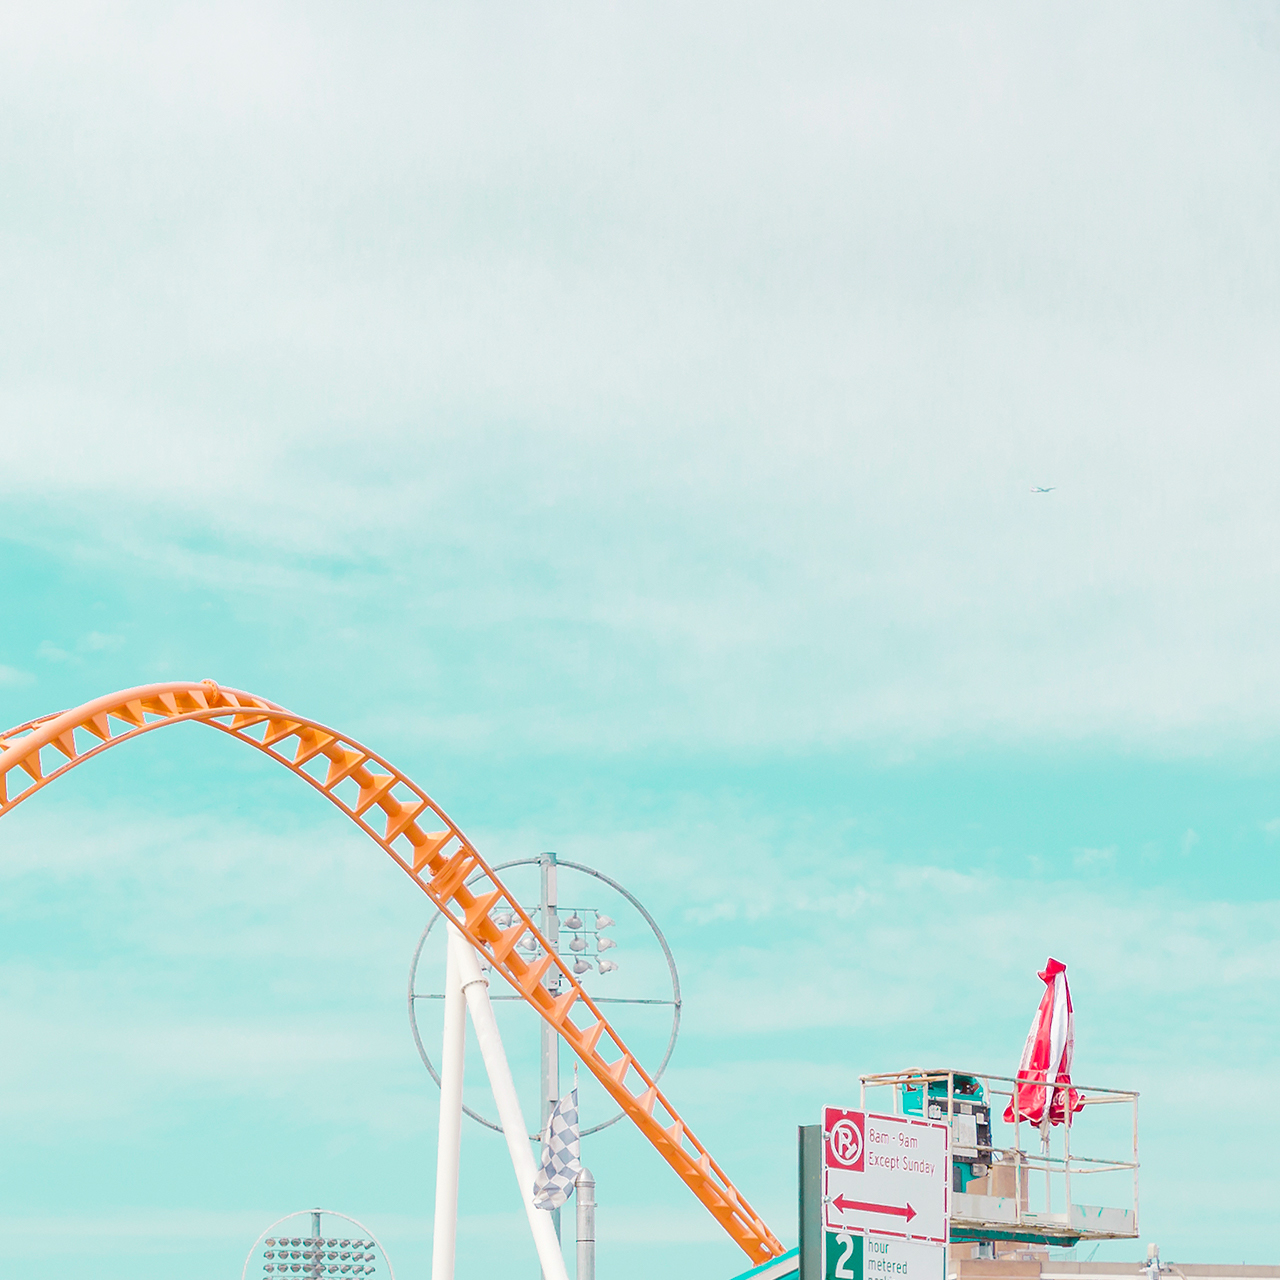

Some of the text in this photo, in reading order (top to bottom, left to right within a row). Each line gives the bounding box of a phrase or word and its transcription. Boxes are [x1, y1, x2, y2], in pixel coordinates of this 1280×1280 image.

[869, 1128, 889, 1144] 8am
[899, 1132, 918, 1149] 9am
[869, 1151, 935, 1177] Except Sunday
[835, 1233, 854, 1280] 2
[868, 1238, 889, 1254] hour
[868, 1258, 908, 1274] metered
